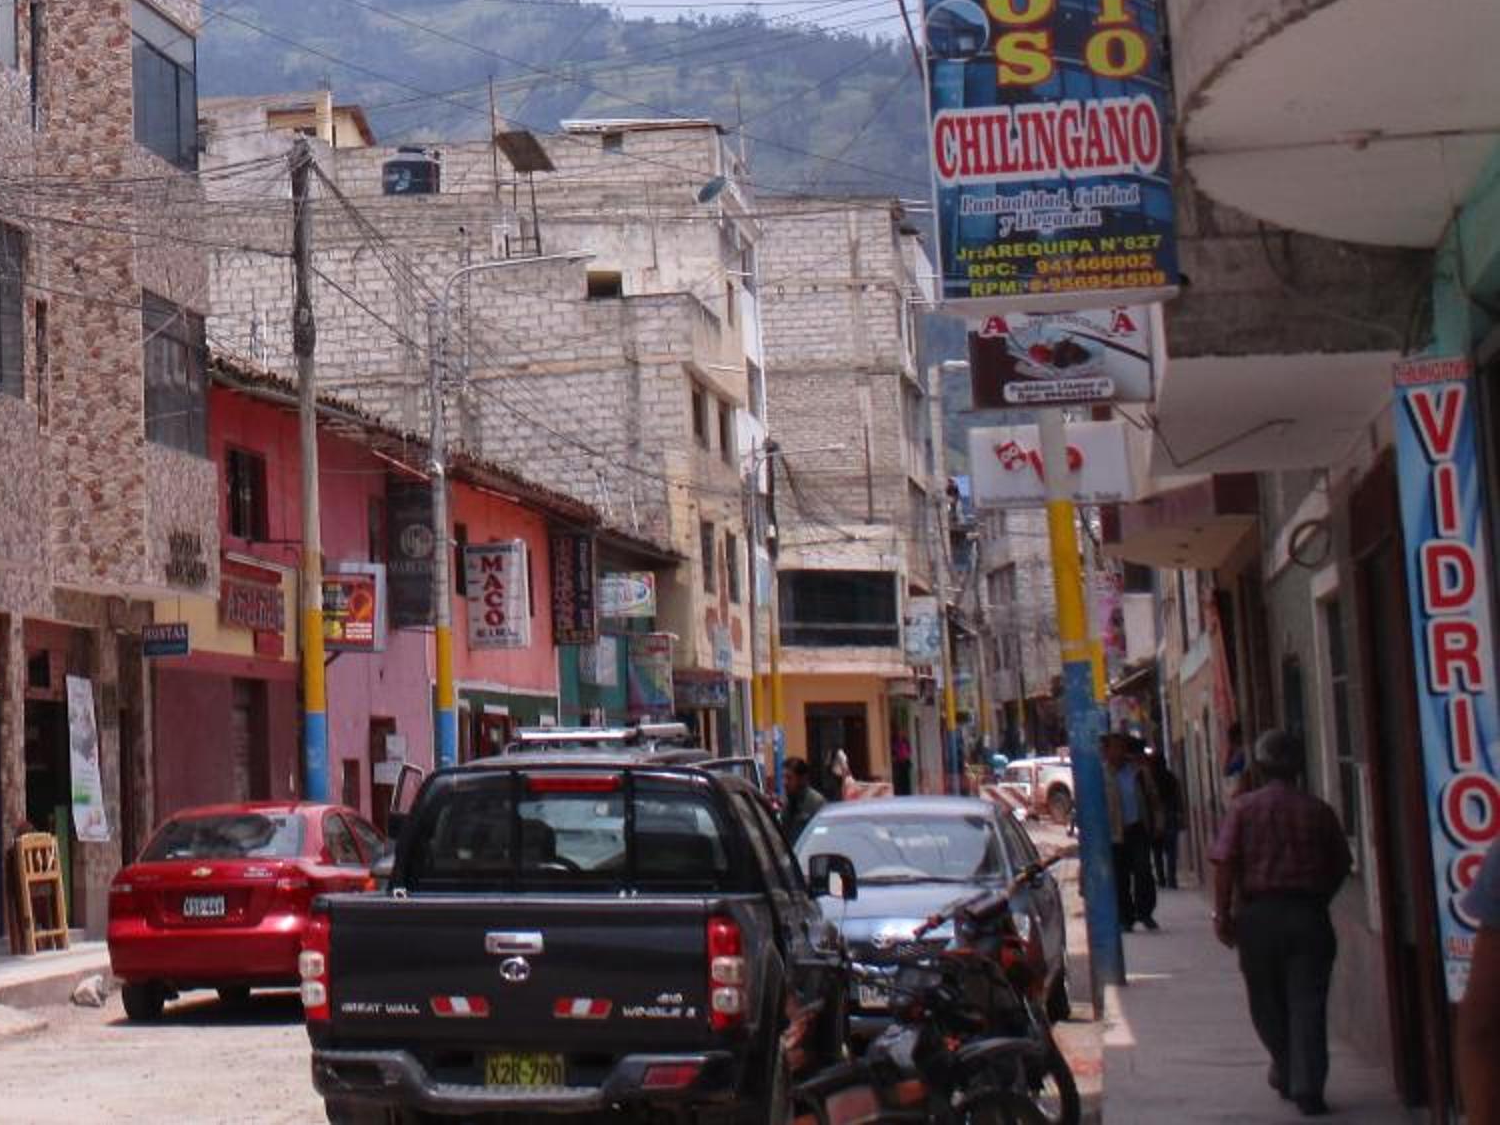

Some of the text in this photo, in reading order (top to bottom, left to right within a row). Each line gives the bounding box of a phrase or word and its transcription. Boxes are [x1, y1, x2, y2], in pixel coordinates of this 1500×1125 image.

[934, 101, 1159, 180] CHILINGANO
[481, 555, 505, 627] MACO
[341, 1002, 420, 1014] GREAT WALL
